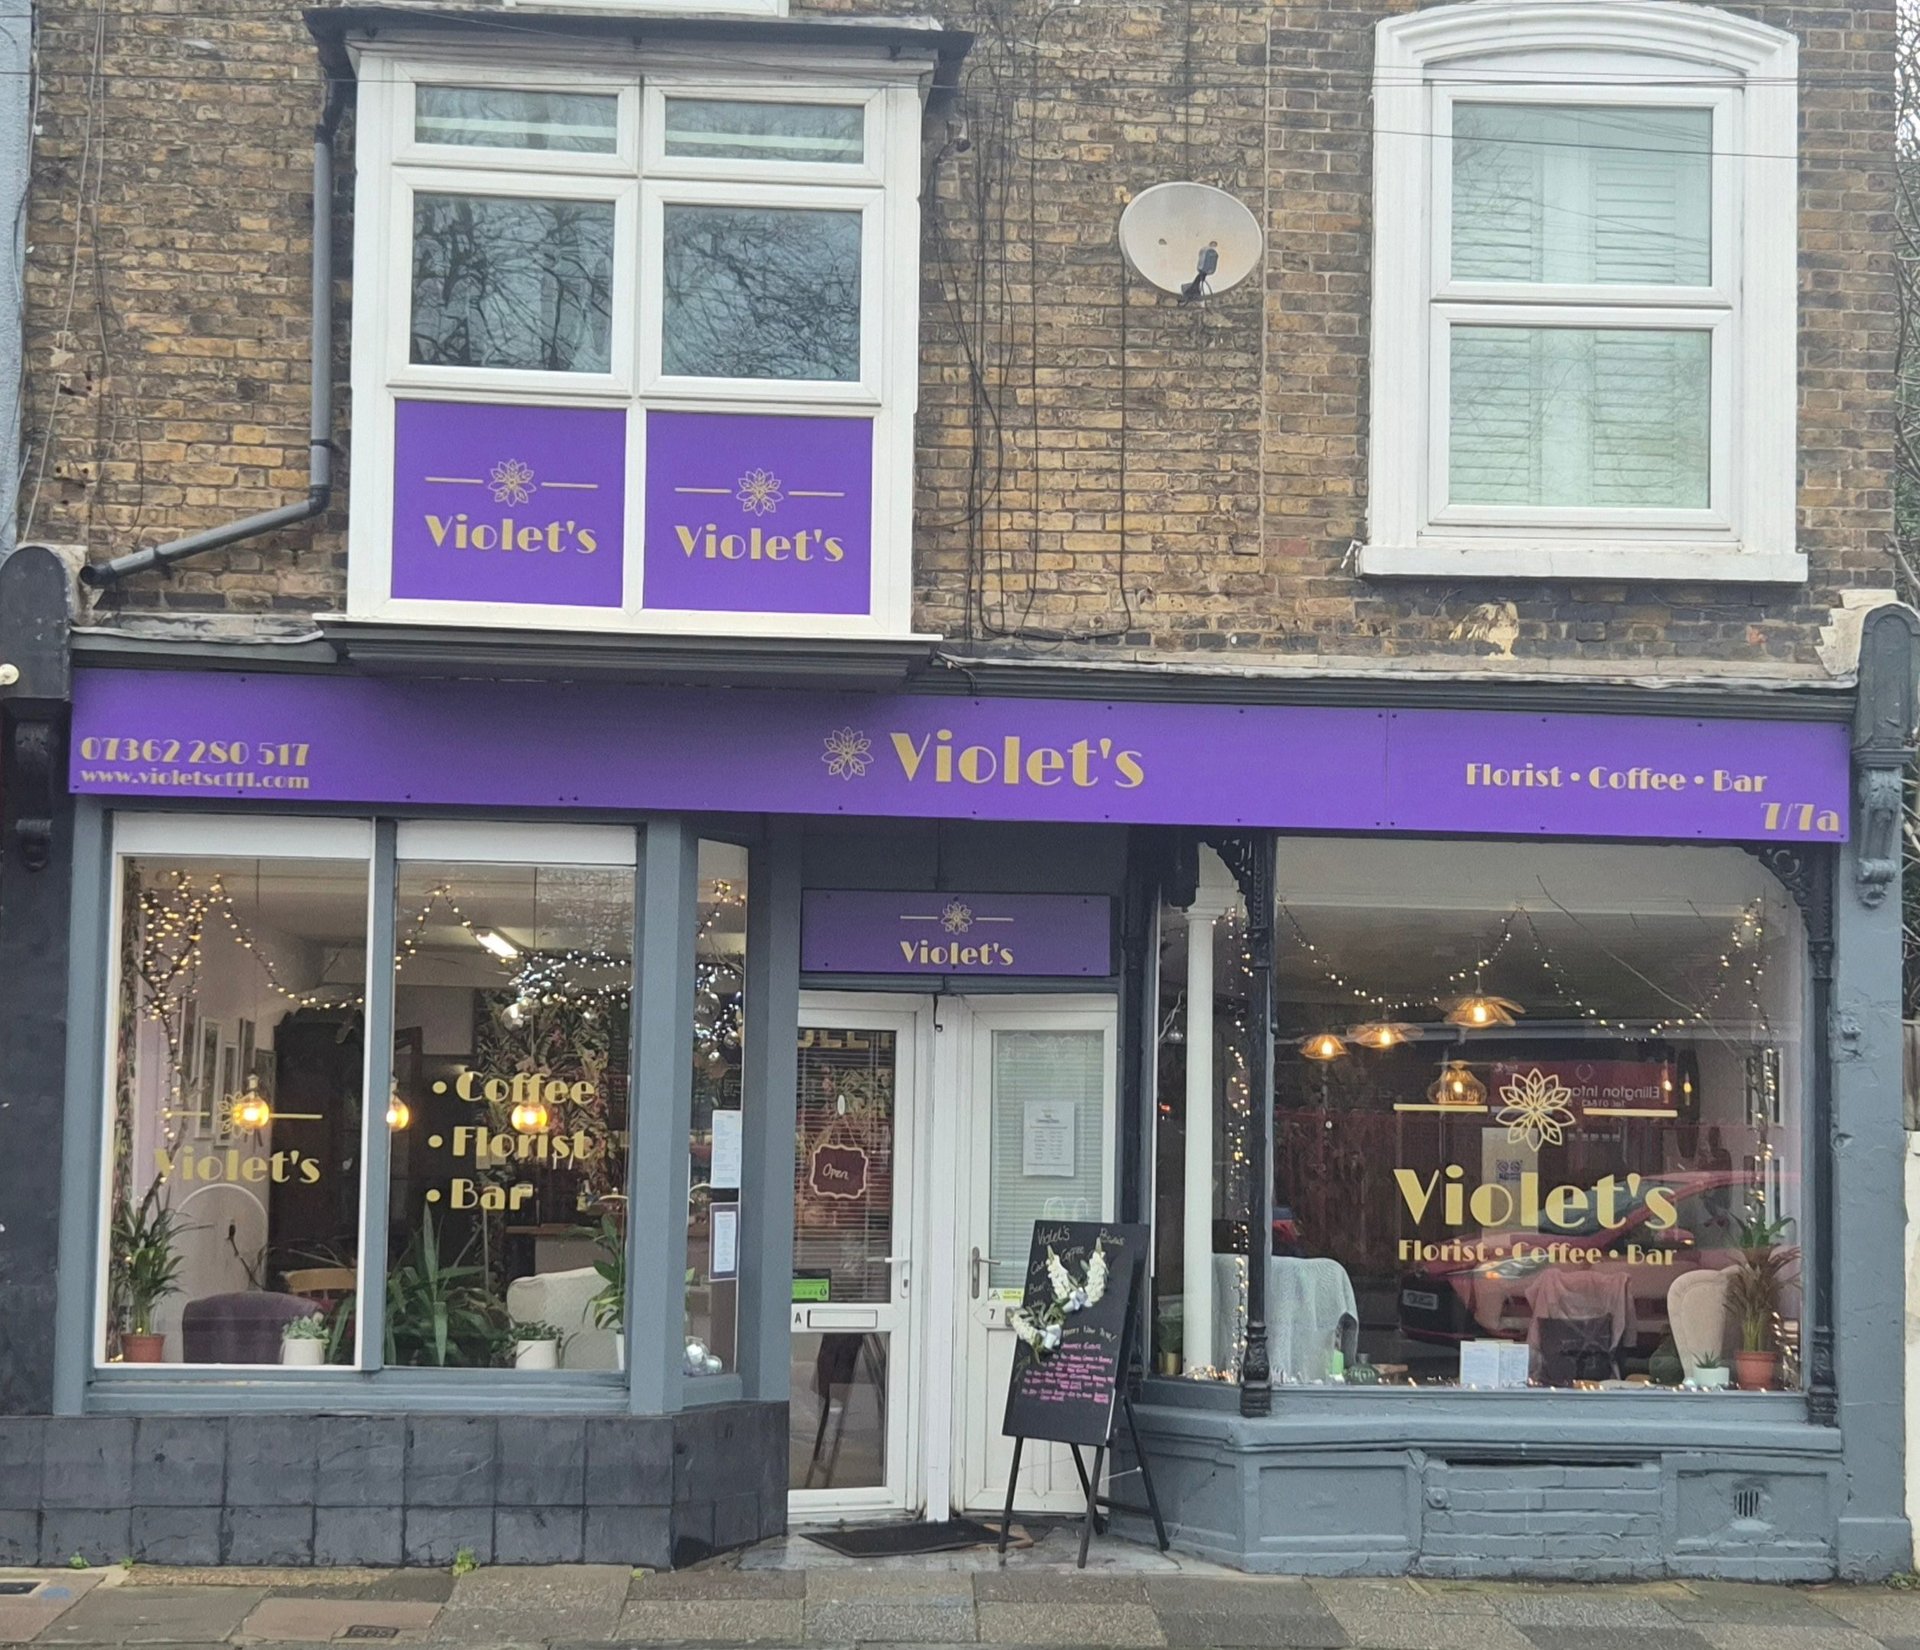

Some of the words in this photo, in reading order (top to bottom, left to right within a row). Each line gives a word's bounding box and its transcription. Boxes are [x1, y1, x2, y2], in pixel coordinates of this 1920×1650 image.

[425, 513, 598, 554] Violet's
[674, 523, 845, 562] Violet's
[80, 737, 180, 763] 07362
[187, 740, 250, 766] 280
[257, 743, 311, 767] 517
[890, 729, 1145, 788] Violet's
[1465, 763, 1562, 788] Florist
[1588, 766, 1686, 791] Coffee
[1712, 770, 1767, 793] Bar
[1760, 801, 1840, 833] 7/7a
[900, 940, 1014, 966] Violet's
[456, 1071, 596, 1104] Coffee
[452, 1126, 592, 1162] Florist
[153, 1147, 321, 1185] Violet's
[822, 1162, 850, 1181] Open
[450, 1180, 533, 1212] Bar
[1393, 1165, 1677, 1230] Violet's
[1398, 1239, 1490, 1264] Florist
[1511, 1241, 1602, 1266] Coffee
[1627, 1243, 1677, 1267] Bar
[794, 1311, 802, 1324] A
[988, 1308, 996, 1321] 7
